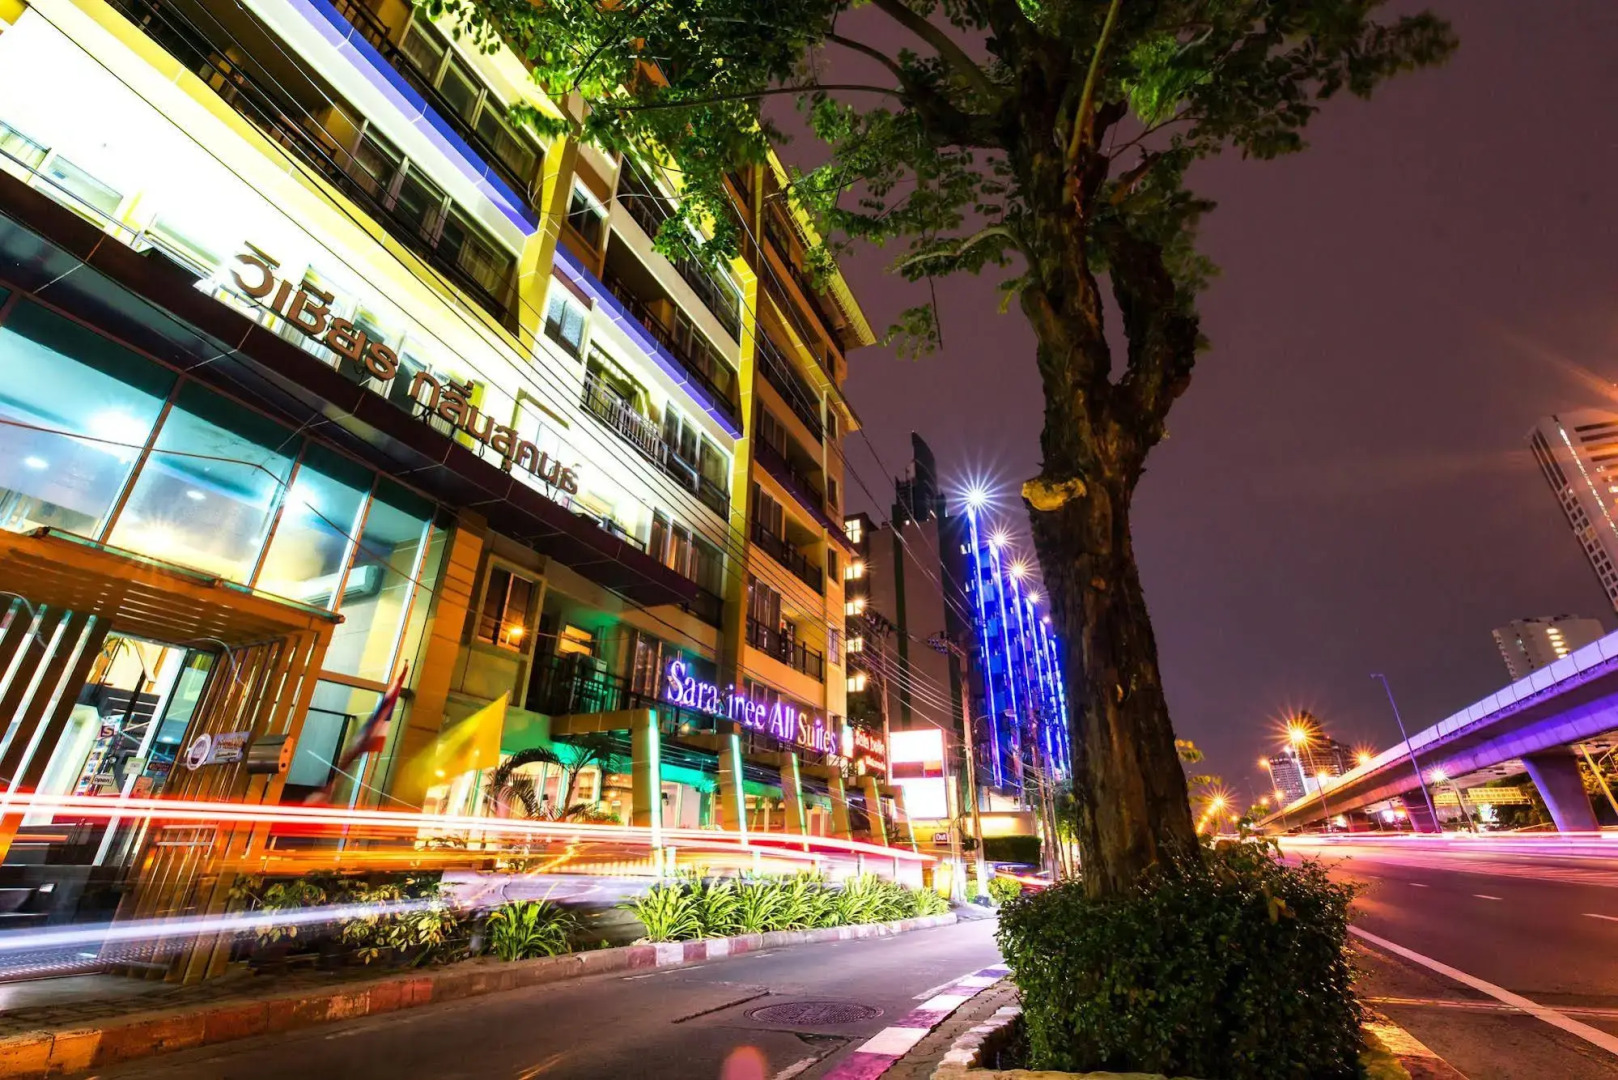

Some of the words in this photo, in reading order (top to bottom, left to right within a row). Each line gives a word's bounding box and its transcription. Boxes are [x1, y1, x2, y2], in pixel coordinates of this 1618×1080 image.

[229, 240, 399, 381] วิเชียร
[667, 660, 767, 730] Sarainee
[769, 702, 796, 740] All
[797, 712, 837, 754] Suites
